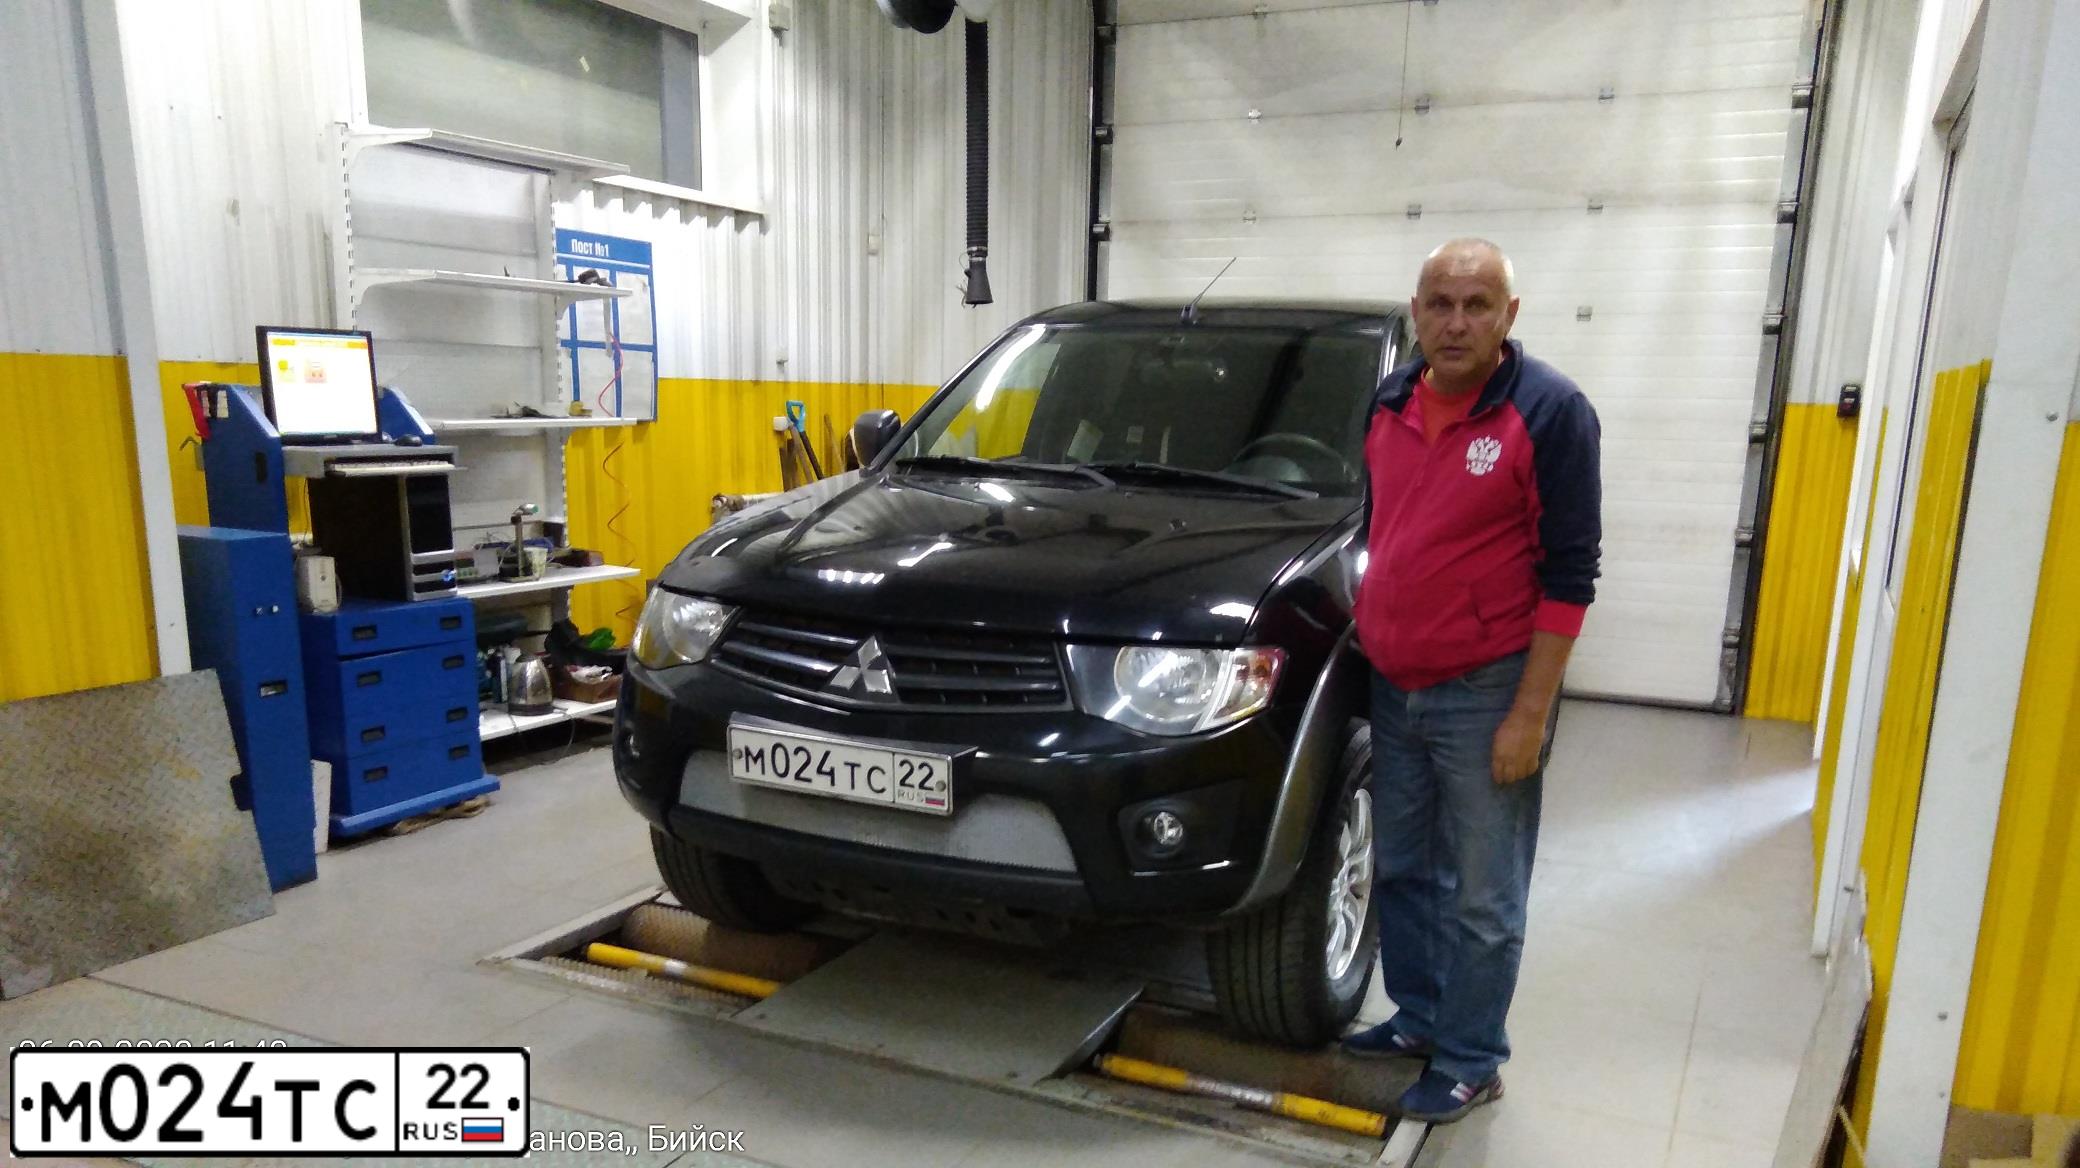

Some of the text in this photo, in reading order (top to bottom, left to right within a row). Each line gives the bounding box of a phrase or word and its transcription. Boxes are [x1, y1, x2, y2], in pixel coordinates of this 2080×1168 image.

[571, 238, 609, 258] Пост №1
[743, 742, 935, 794] М024ТС 22
[898, 789, 925, 803] RUS
